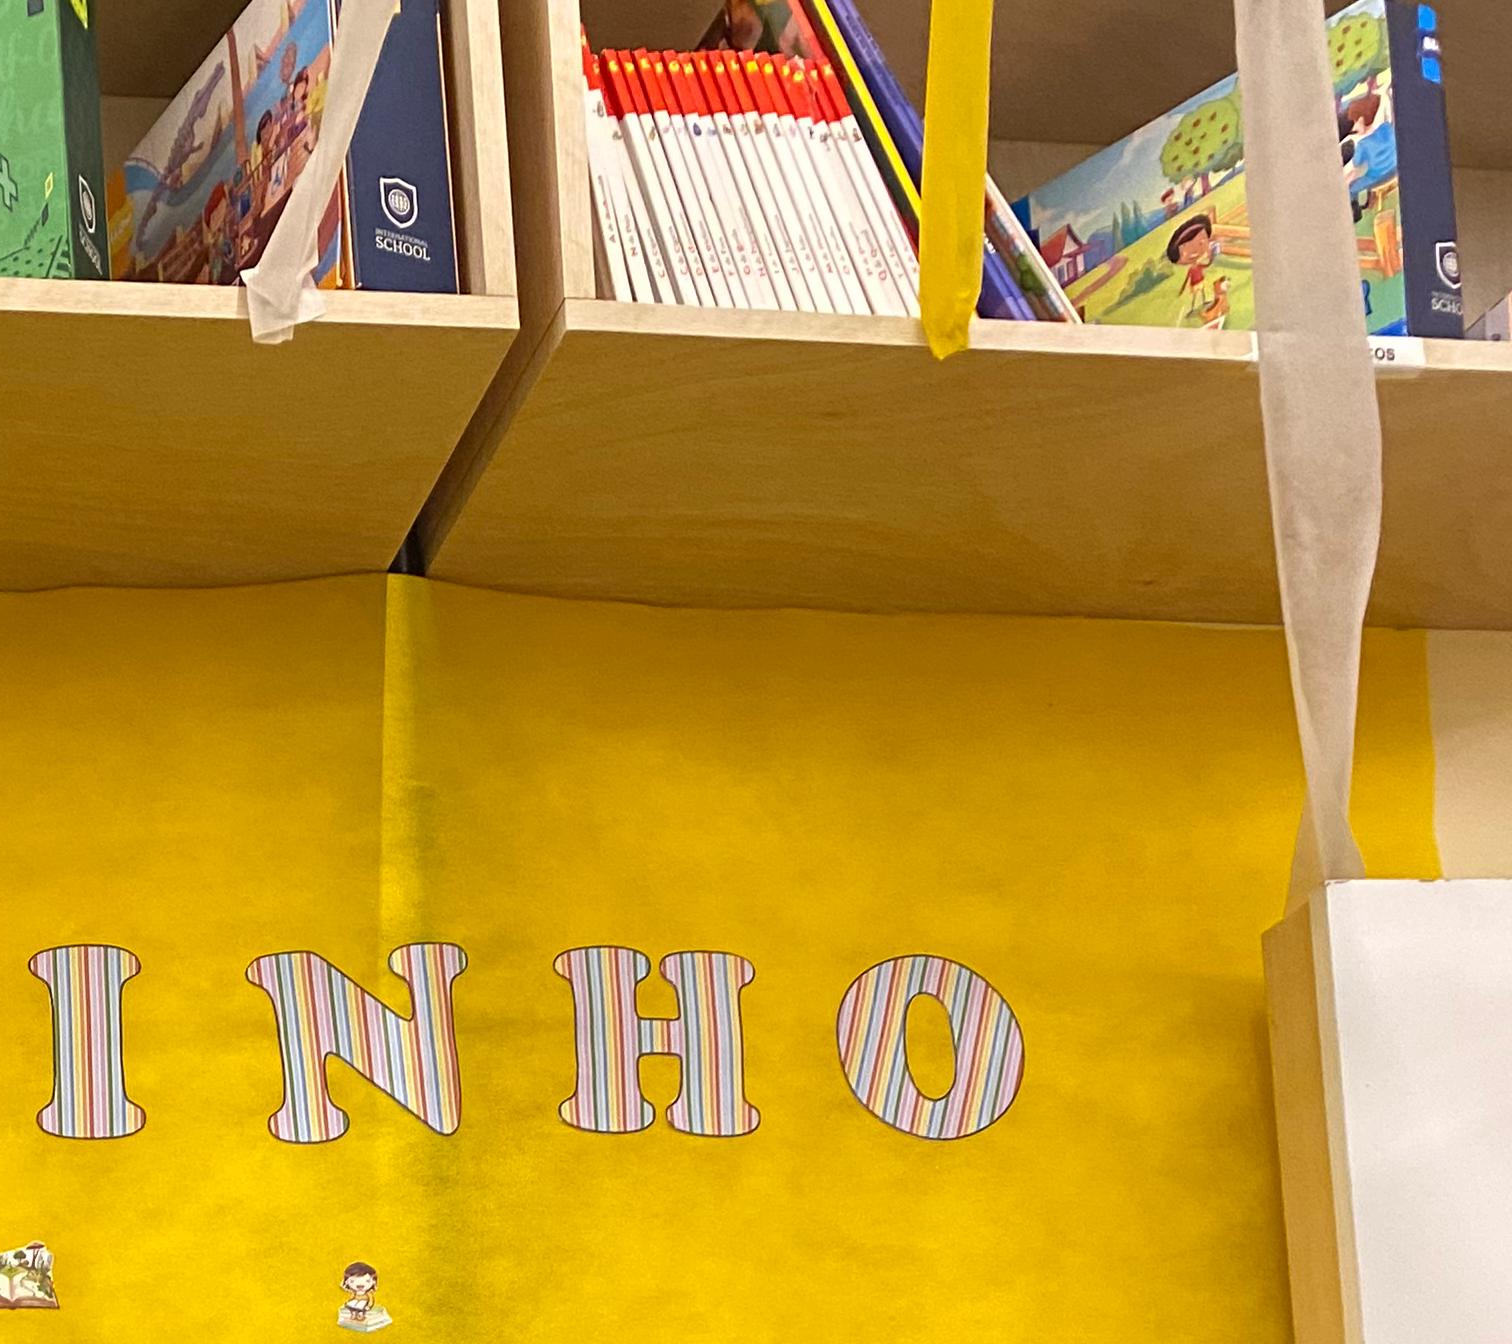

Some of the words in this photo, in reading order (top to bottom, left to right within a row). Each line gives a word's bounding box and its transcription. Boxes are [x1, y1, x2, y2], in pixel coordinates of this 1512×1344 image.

[375, 236, 431, 261] SCHOOL
[1431, 297, 1464, 315] SCHO
[1369, 347, 1396, 361] OS
